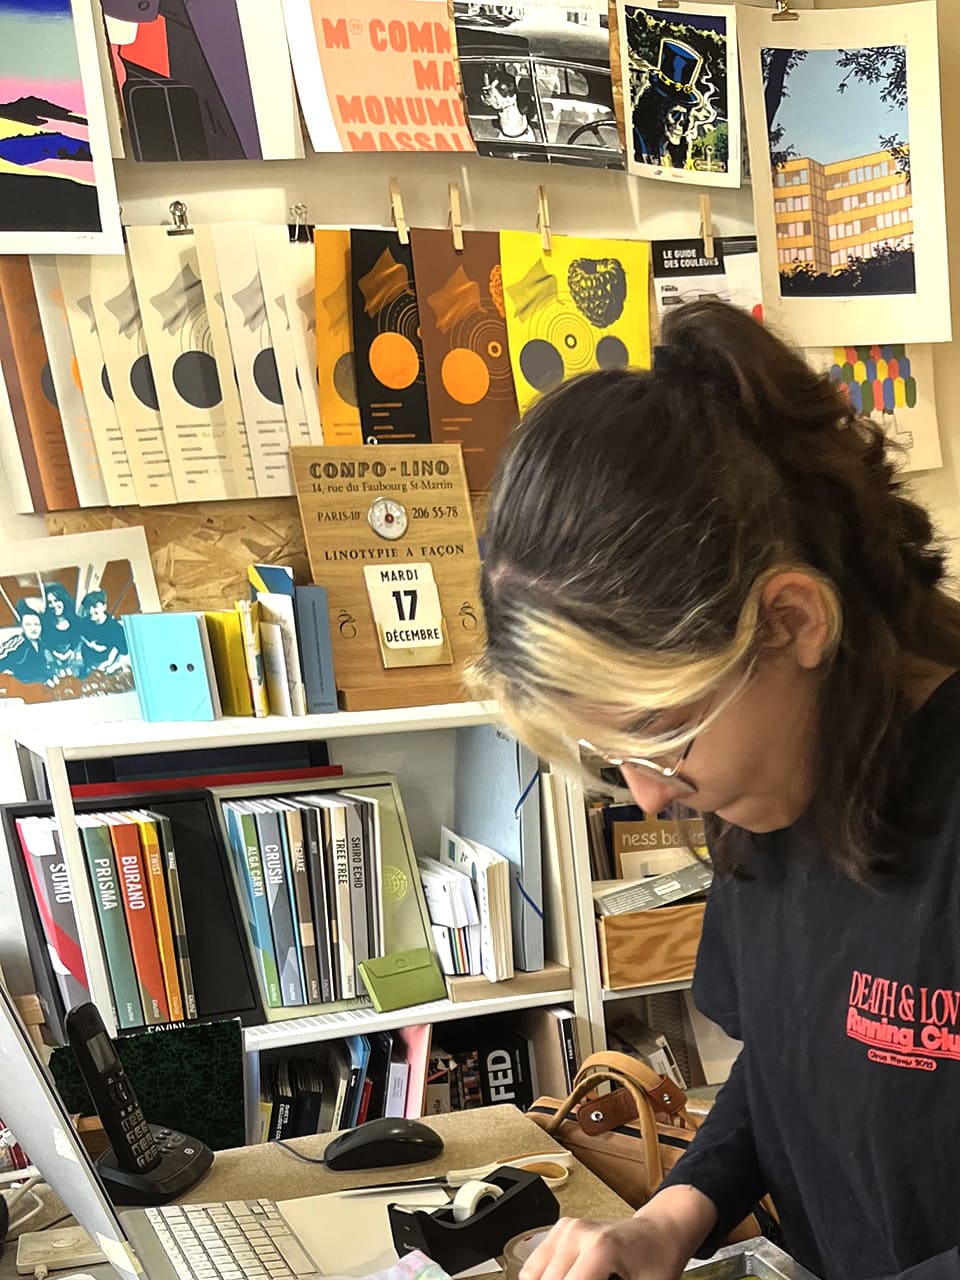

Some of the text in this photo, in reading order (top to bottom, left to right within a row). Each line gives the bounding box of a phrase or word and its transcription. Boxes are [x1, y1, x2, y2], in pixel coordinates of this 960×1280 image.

[663, 249, 697, 259] LE GUIDE
[664, 260, 679, 268] DES
[327, 485, 344, 493] rue
[347, 481, 359, 492] du
[362, 481, 408, 493] Faubourg
[412, 506, 458, 519] 206 55-78
[324, 544, 464, 561] LINOTYPIE A FAÇON
[380, 569, 418, 582] MARDI
[392, 589, 418, 621] 17
[386, 628, 440, 643] DÉCEMBRE
[622, 832, 658, 846] ness
[247, 846, 264, 898] ALGA CARTA
[265, 844, 283, 885] CRUSH
[335, 838, 349, 885] TREE FREE
[351, 837, 364, 888] SHIRO ECHO
[50, 863, 73, 904] SUMO
[94, 858, 118, 911] PRISMA
[121, 855, 145, 911] BURANO
[849, 971, 898, 1018] DEATH
[898, 985, 915, 1022] &
[847, 1007, 914, 1053] Running
[487, 1049, 515, 1103] FED
